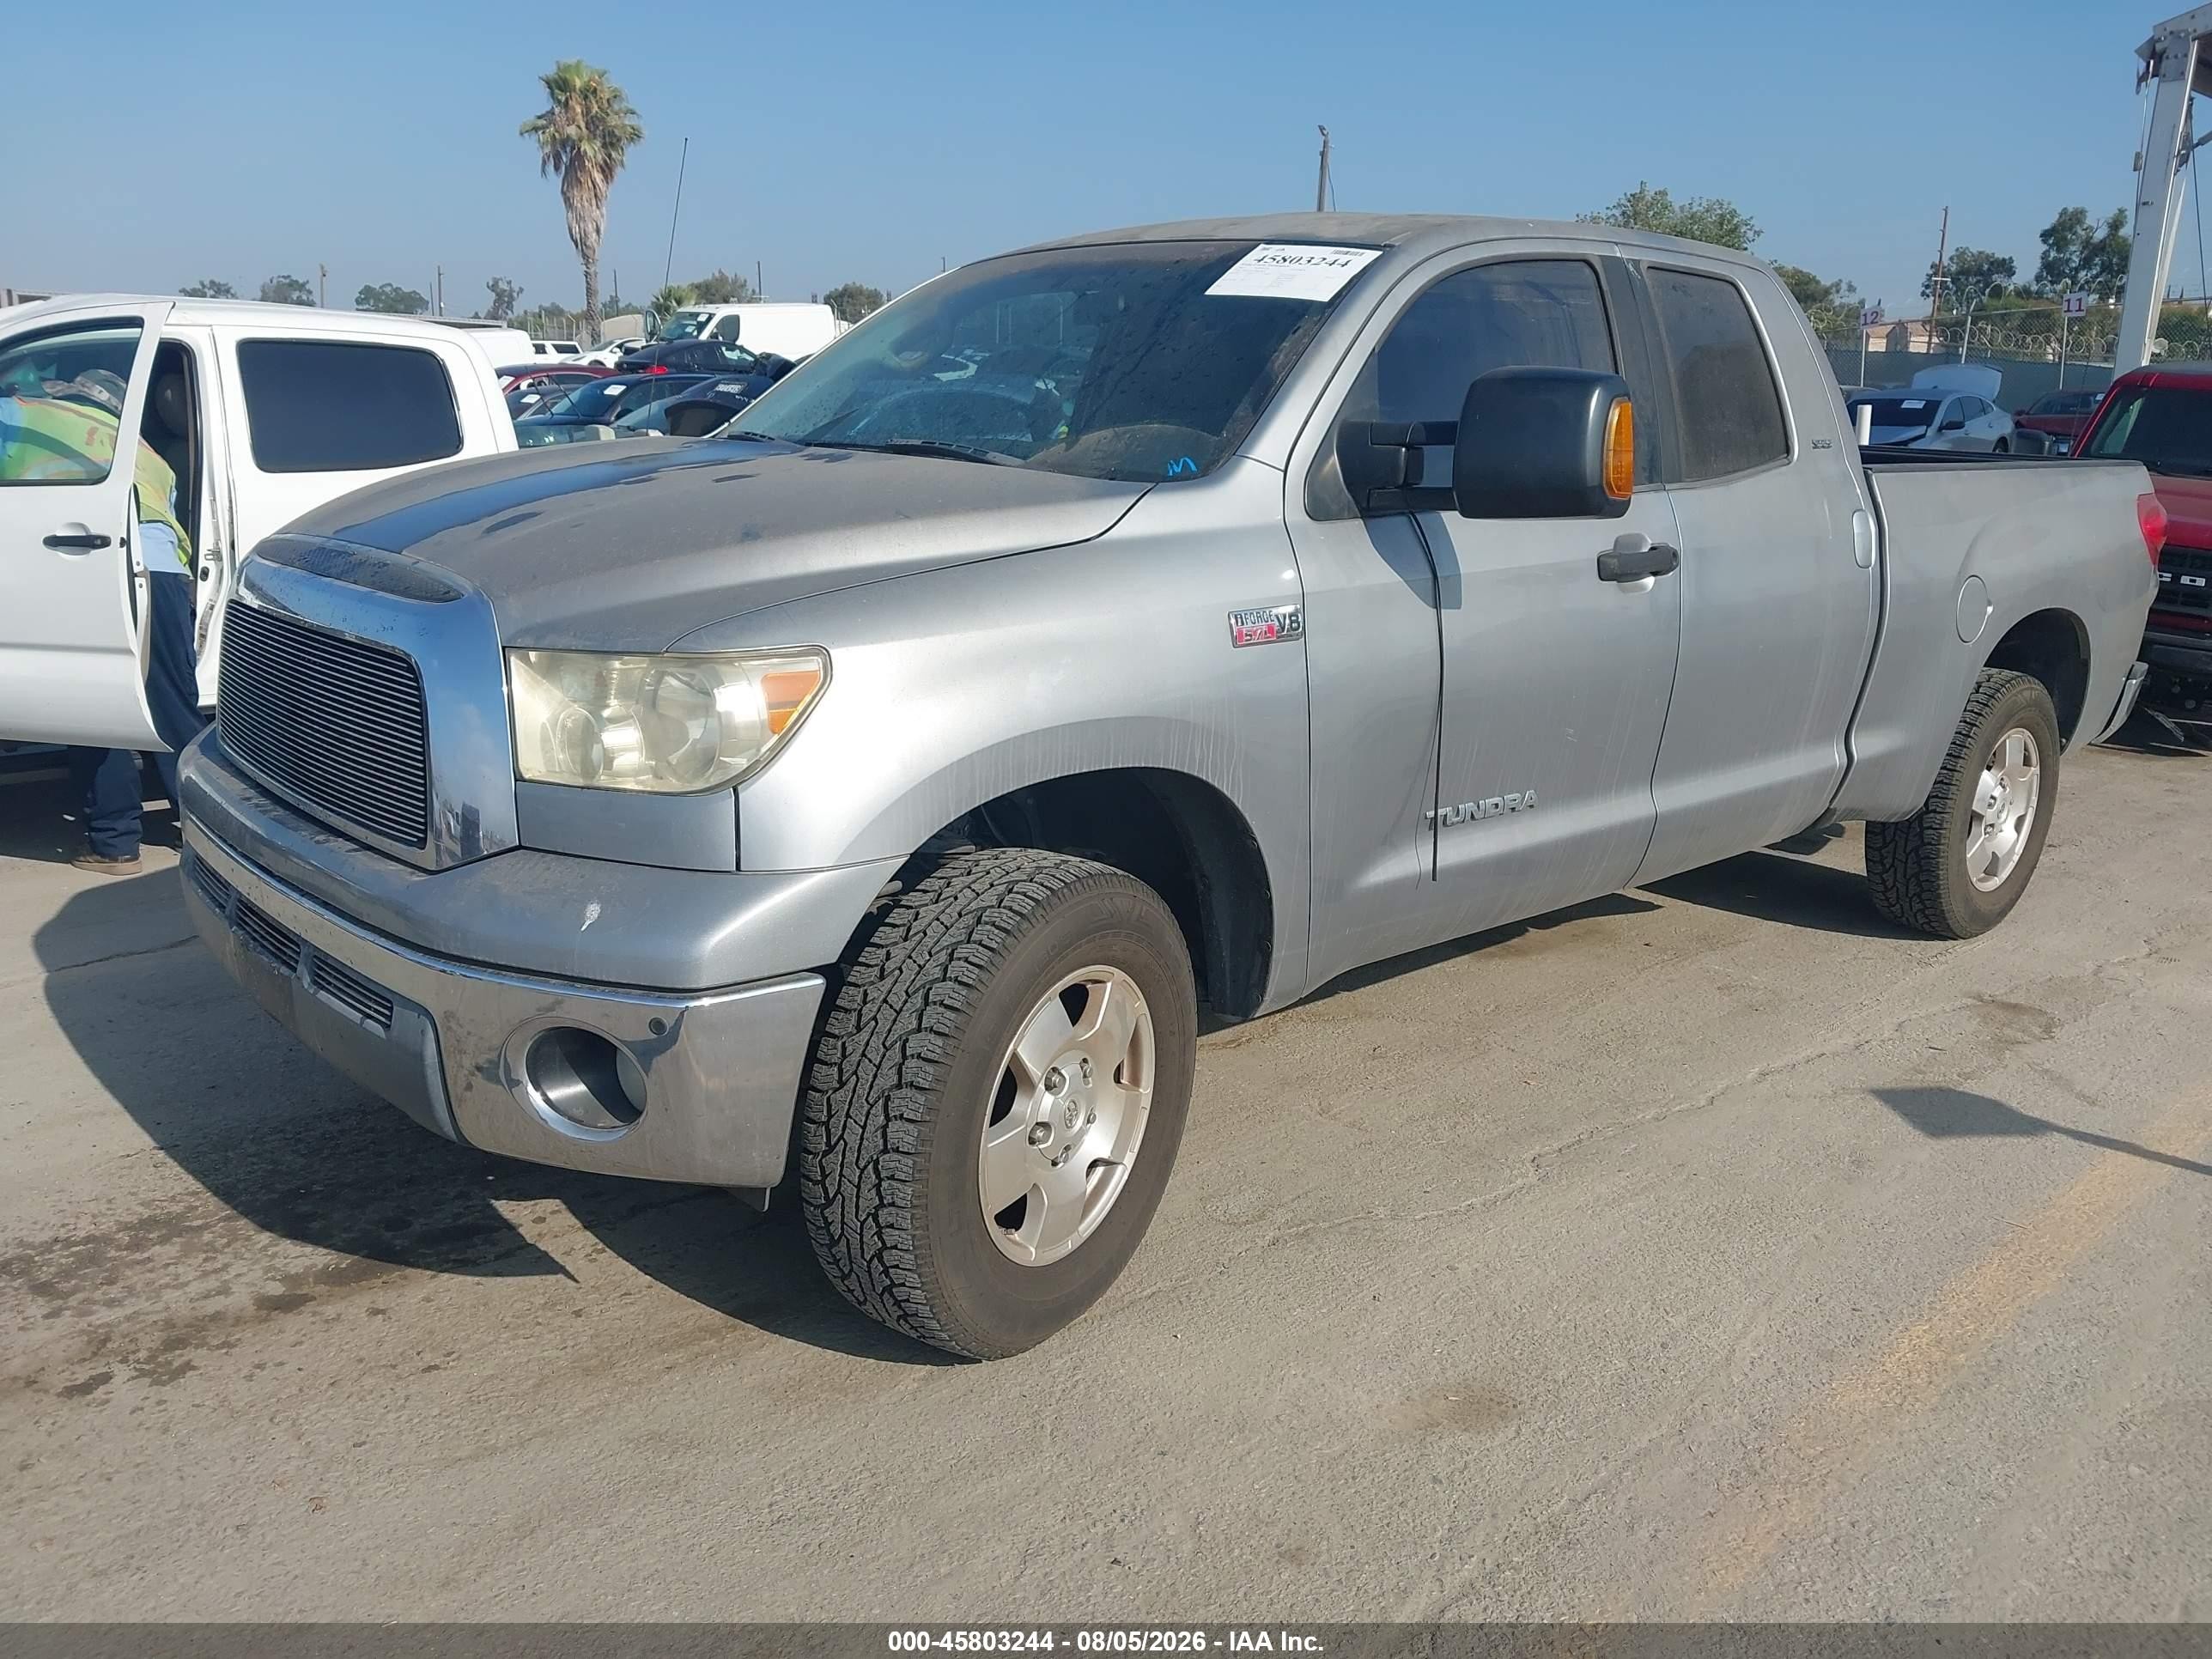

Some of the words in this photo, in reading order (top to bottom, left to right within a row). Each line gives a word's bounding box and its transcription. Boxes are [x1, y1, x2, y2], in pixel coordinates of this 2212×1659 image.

[1253, 253, 1353, 268] 45803244
[2063, 296, 2085, 313] 11
[1861, 310, 1879, 326] 12
[1275, 611, 1304, 635] V8
[1425, 789, 1538, 831] TUNDRA
